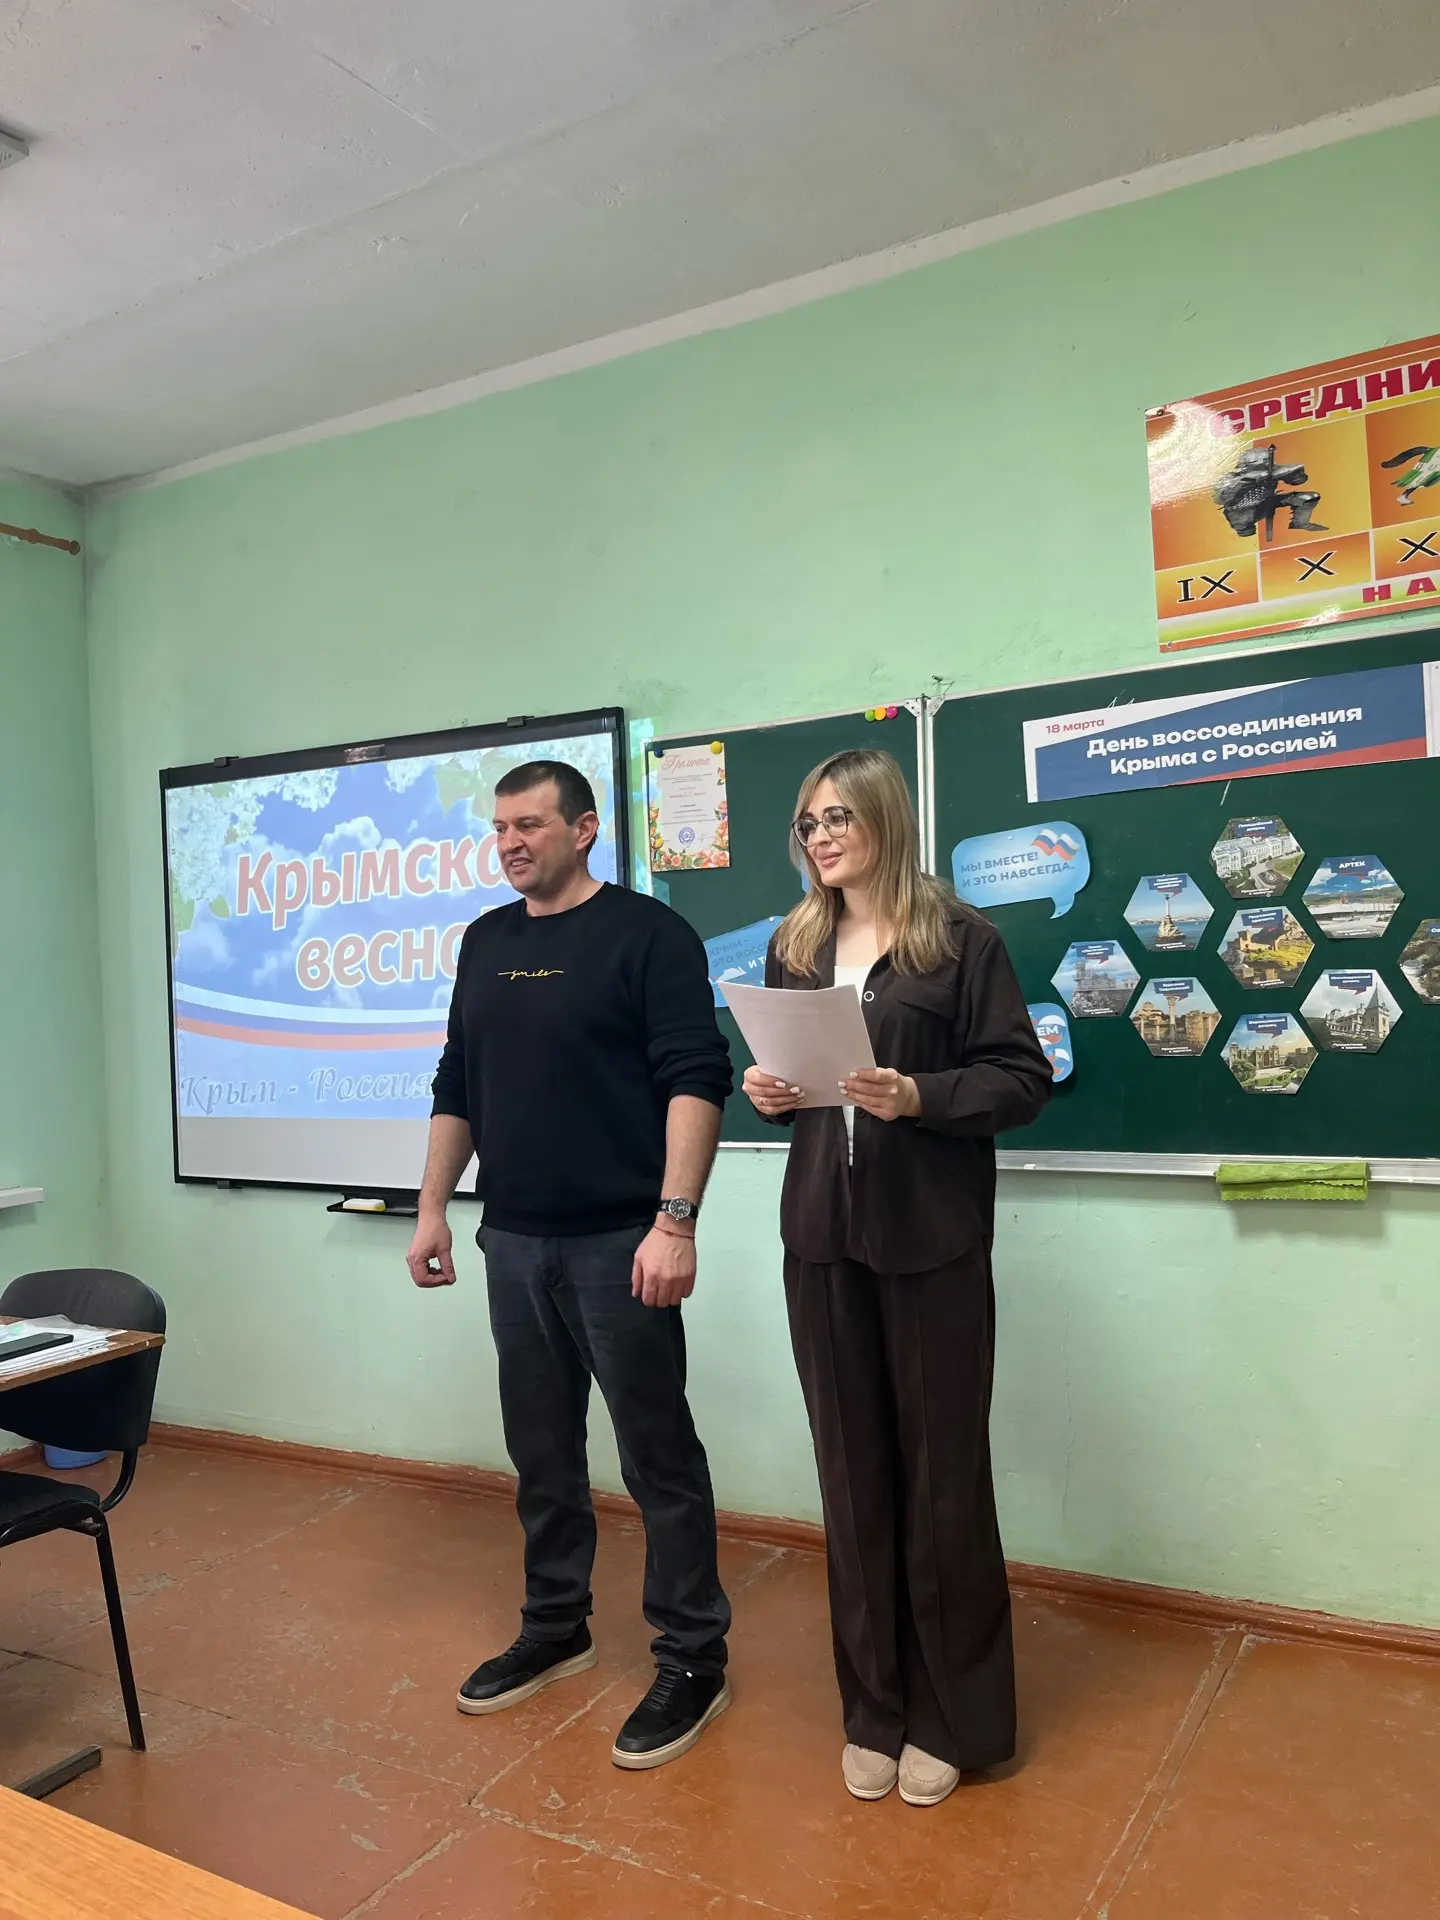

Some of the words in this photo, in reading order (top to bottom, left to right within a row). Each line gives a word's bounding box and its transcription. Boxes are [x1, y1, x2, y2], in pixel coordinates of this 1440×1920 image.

[1178, 571, 1236, 602] IX
[1295, 551, 1337, 581] X
[1045, 723, 1061, 734] 18
[1063, 718, 1105, 733] марта
[1087, 738, 1148, 758] День
[1152, 707, 1362, 747] воссоединения
[1110, 752, 1197, 775] Крыма
[1202, 749, 1217, 763] с
[1222, 731, 1337, 760] Россией
[961, 863, 981, 873] МЫ
[985, 852, 1039, 869] ВМЕСТЕ!
[963, 879, 971, 888] И
[973, 874, 997, 885] ЭТО
[1000, 862, 1075, 881] НАВСЕГДА.
[1339, 861, 1366, 869] АРТЕК
[708, 940, 742, 956] КРЫМ
[711, 955, 733, 968] ЭТО
[736, 942, 768, 958] РОСС
[1034, 1025, 1059, 1036] ЕМ
[309, 1067, 433, 1101] Россия
